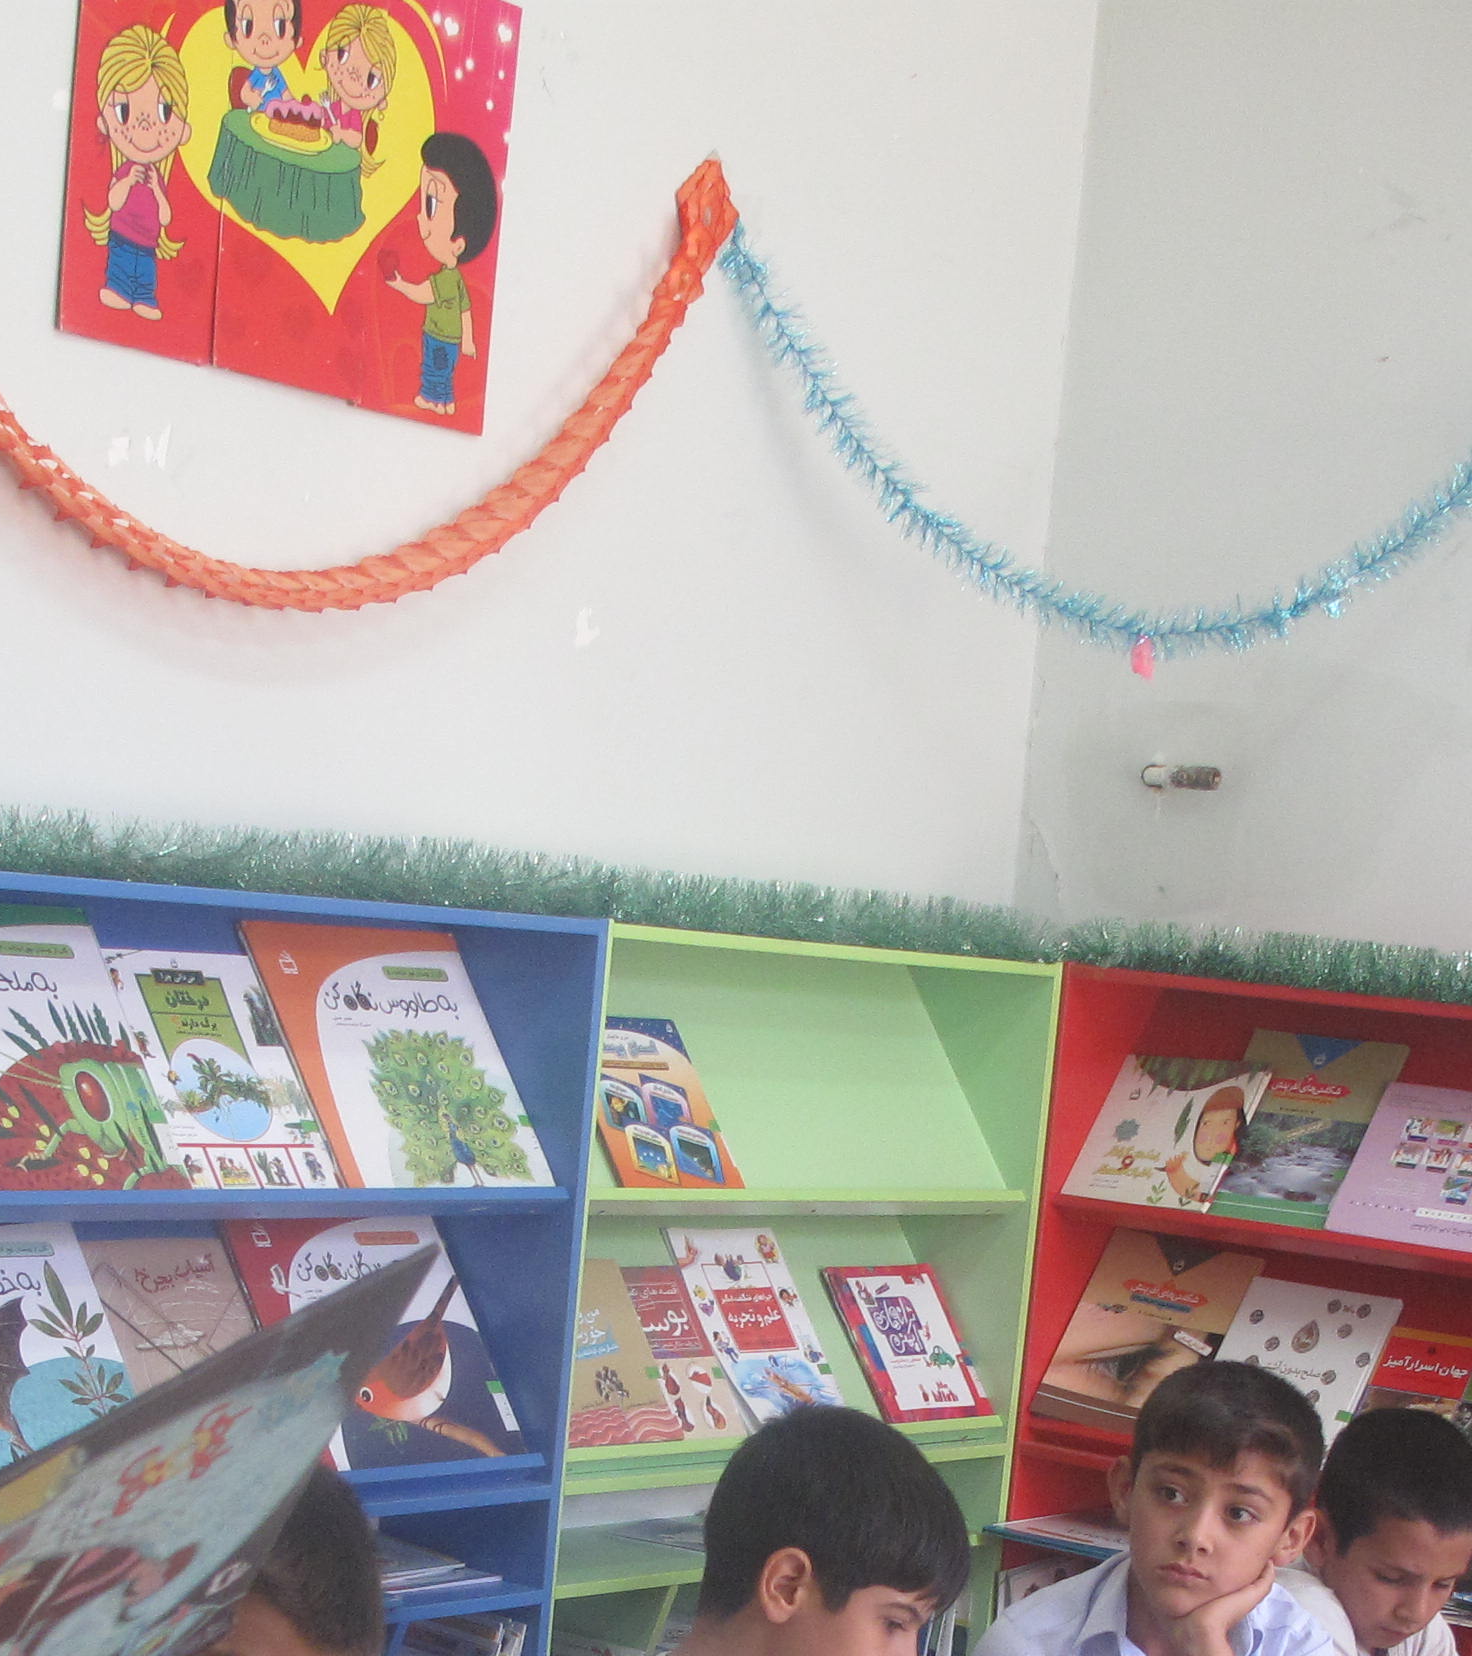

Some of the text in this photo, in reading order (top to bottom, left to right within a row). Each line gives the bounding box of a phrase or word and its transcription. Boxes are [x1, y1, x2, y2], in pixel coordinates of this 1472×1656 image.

[31, 972, 58, 999] به
[323, 982, 341, 1010] کن
[438, 994, 459, 1020] به
[296, 1251, 314, 1282] کن
[16, 1271, 42, 1297] به
[1439, 1365, 1468, 1378] جهان
